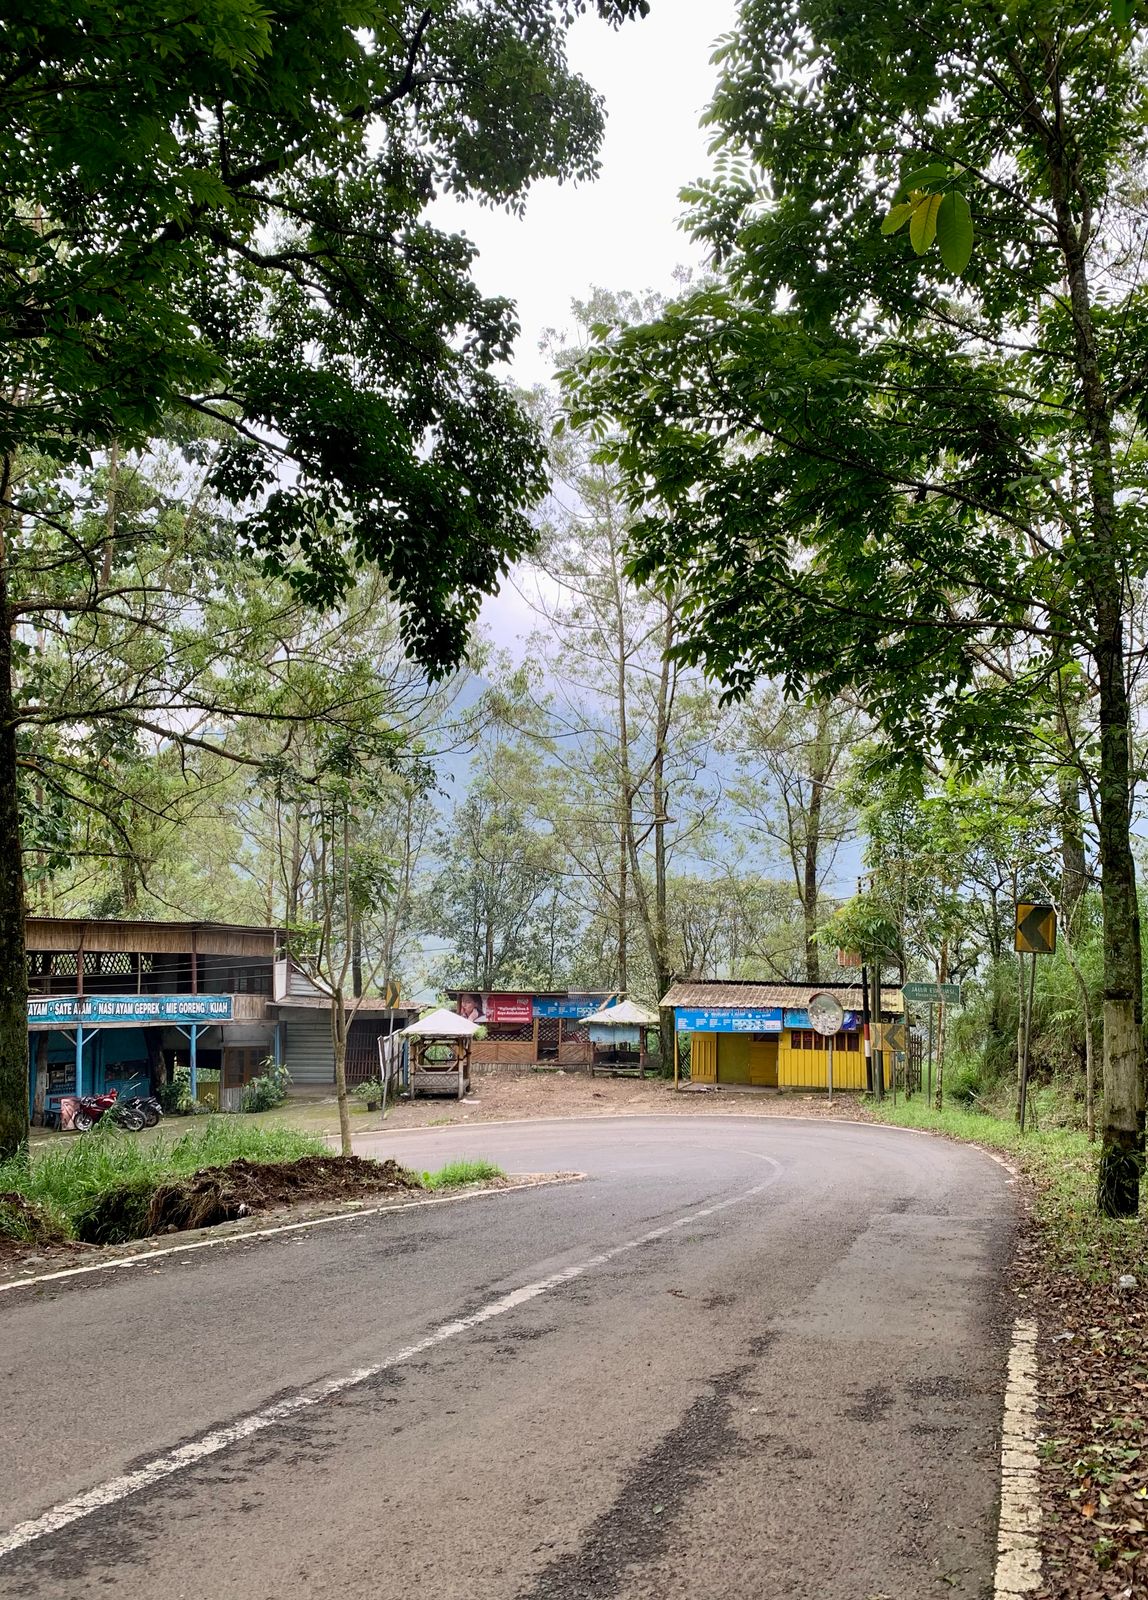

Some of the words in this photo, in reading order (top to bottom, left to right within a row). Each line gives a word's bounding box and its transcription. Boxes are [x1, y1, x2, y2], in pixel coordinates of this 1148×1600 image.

[54, 1002, 73, 1016] SATE
[98, 1002, 115, 1015] NASI
[115, 1002, 134, 1015] AYAM
[134, 1002, 160, 1015] GEPREK
[165, 1002, 178, 1014] MIE
[178, 1002, 205, 1014] GORENG
[210, 1002, 228, 1014] KUAH
